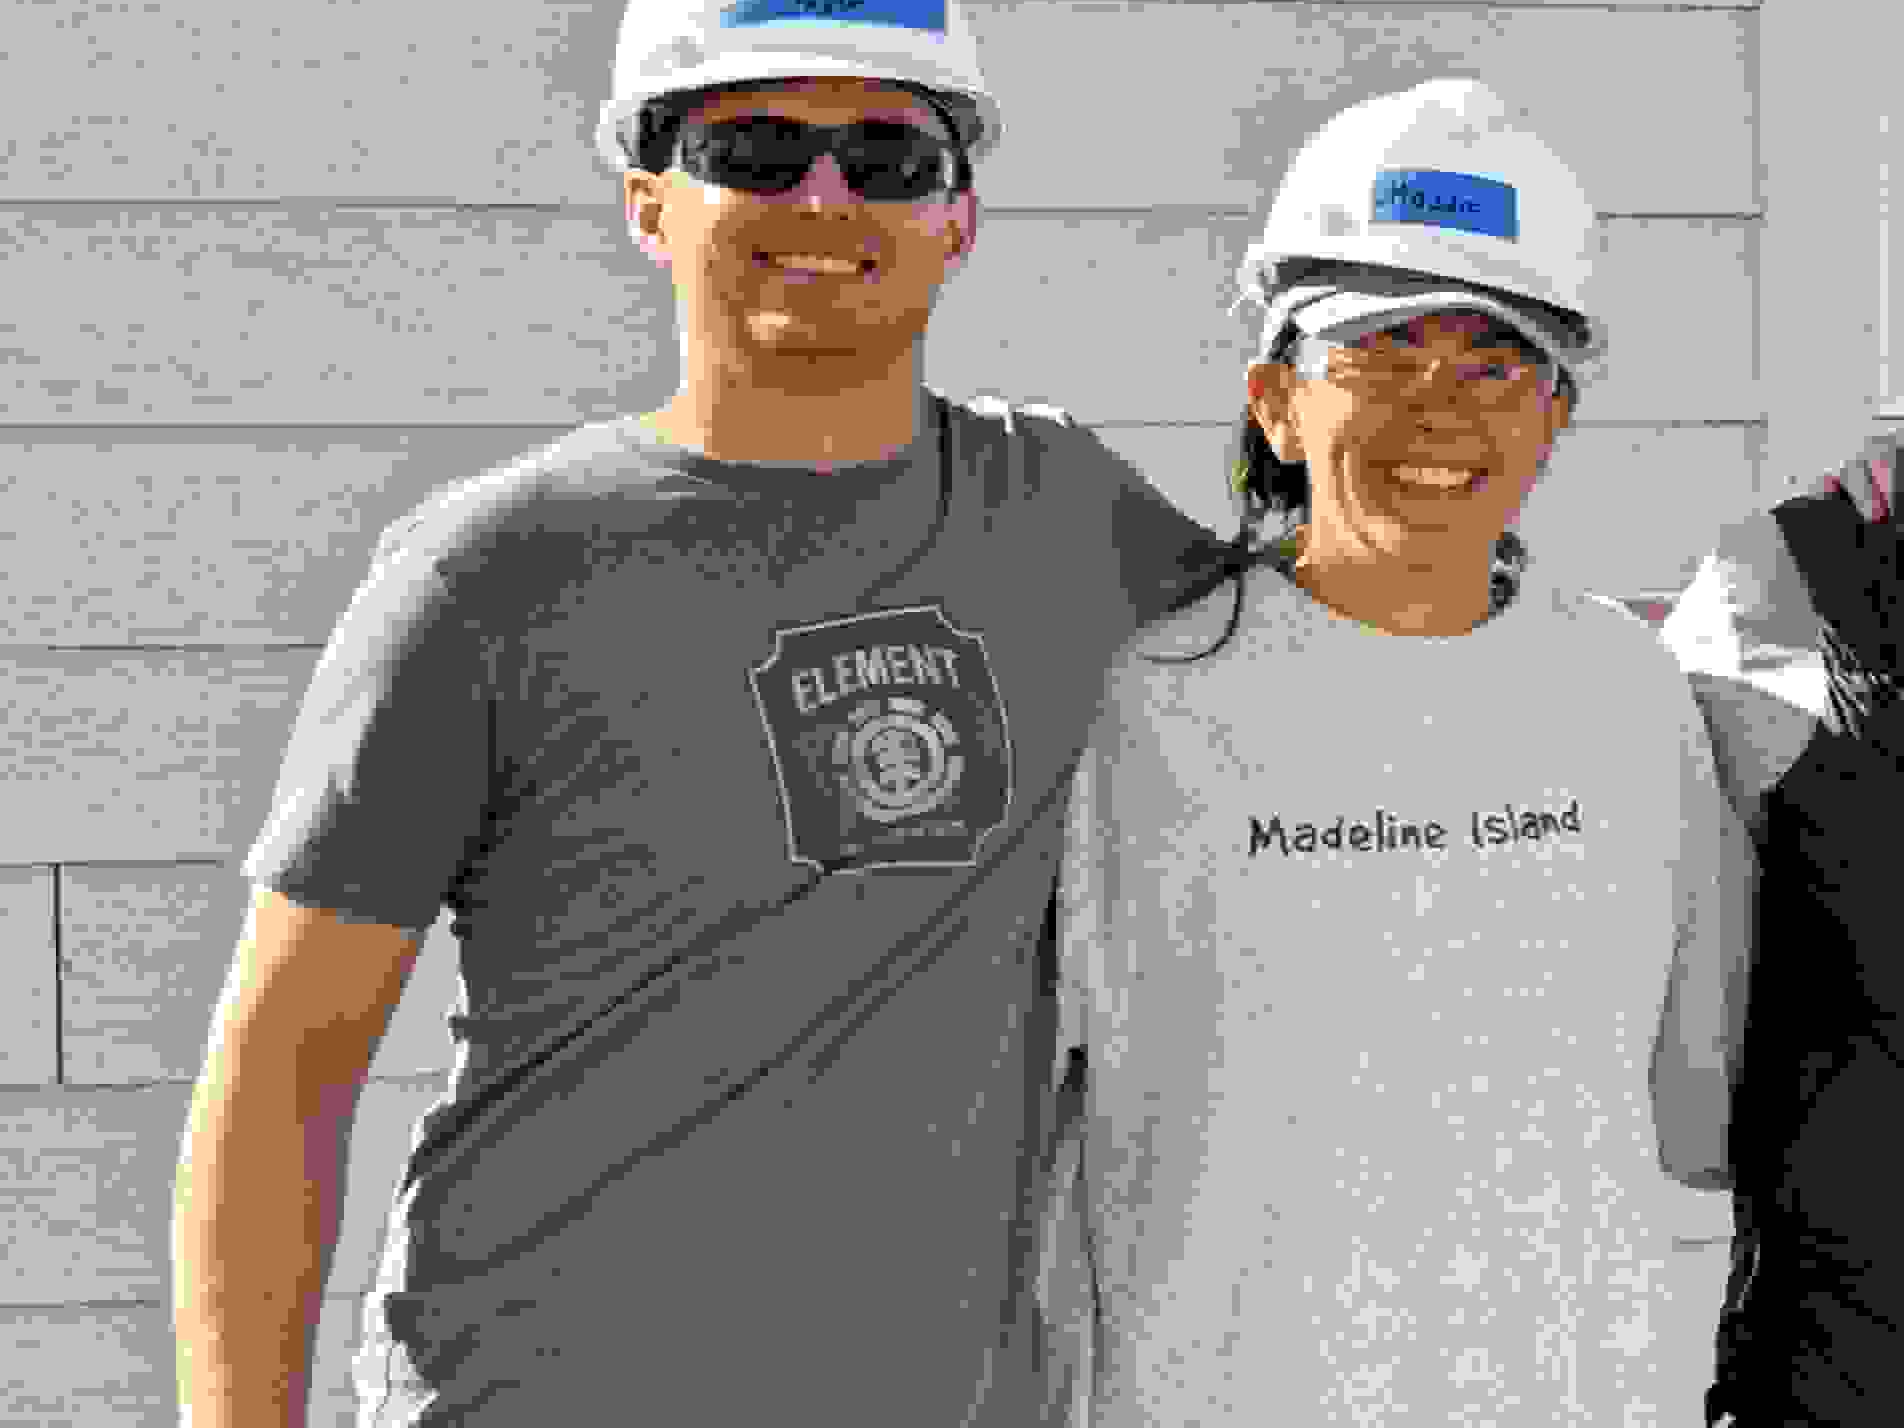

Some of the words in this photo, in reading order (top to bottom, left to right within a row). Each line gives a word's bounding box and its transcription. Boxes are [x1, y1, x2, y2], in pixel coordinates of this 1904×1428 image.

[791, 643, 962, 715] ELEMENT
[1247, 802, 1448, 859] Madeline
[1470, 793, 1586, 853] Island
